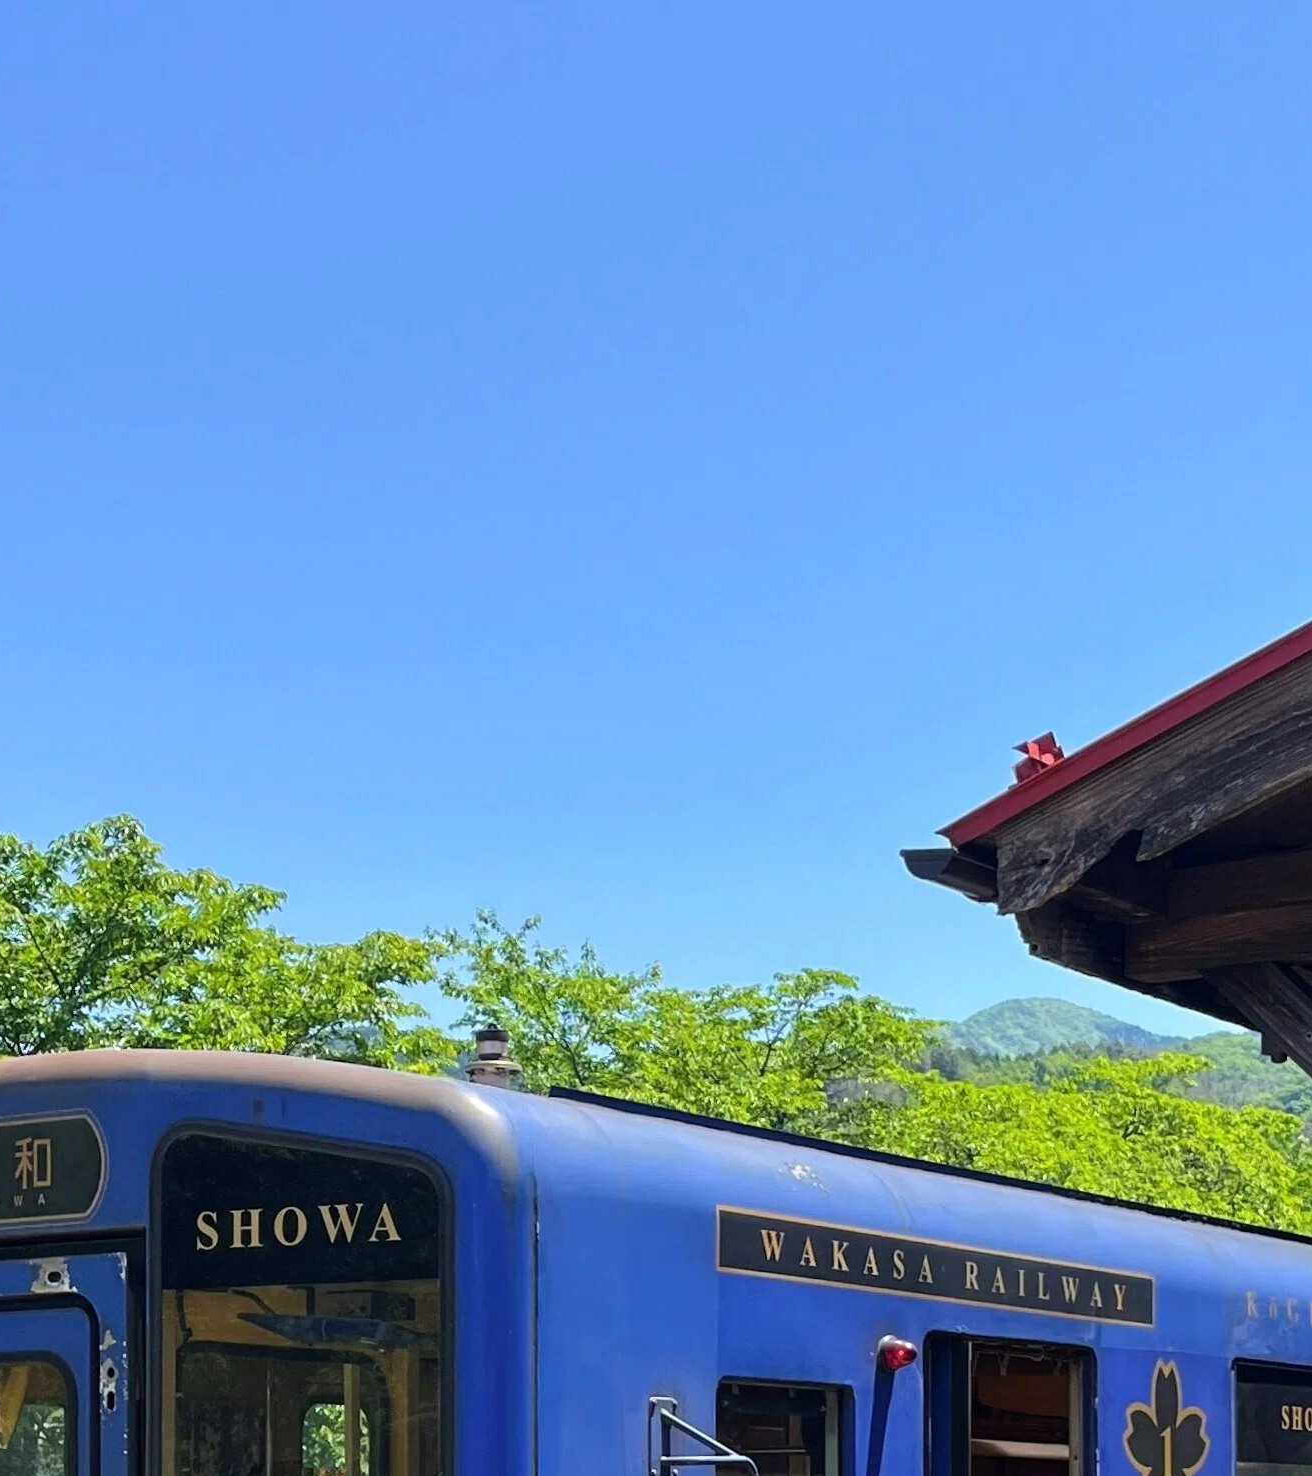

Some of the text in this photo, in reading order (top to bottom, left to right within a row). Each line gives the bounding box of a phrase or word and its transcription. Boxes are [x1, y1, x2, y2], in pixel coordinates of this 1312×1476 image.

[196, 1200, 402, 1251] SHOWA
[759, 1228, 1127, 1312] WAKASA RAILWAY
